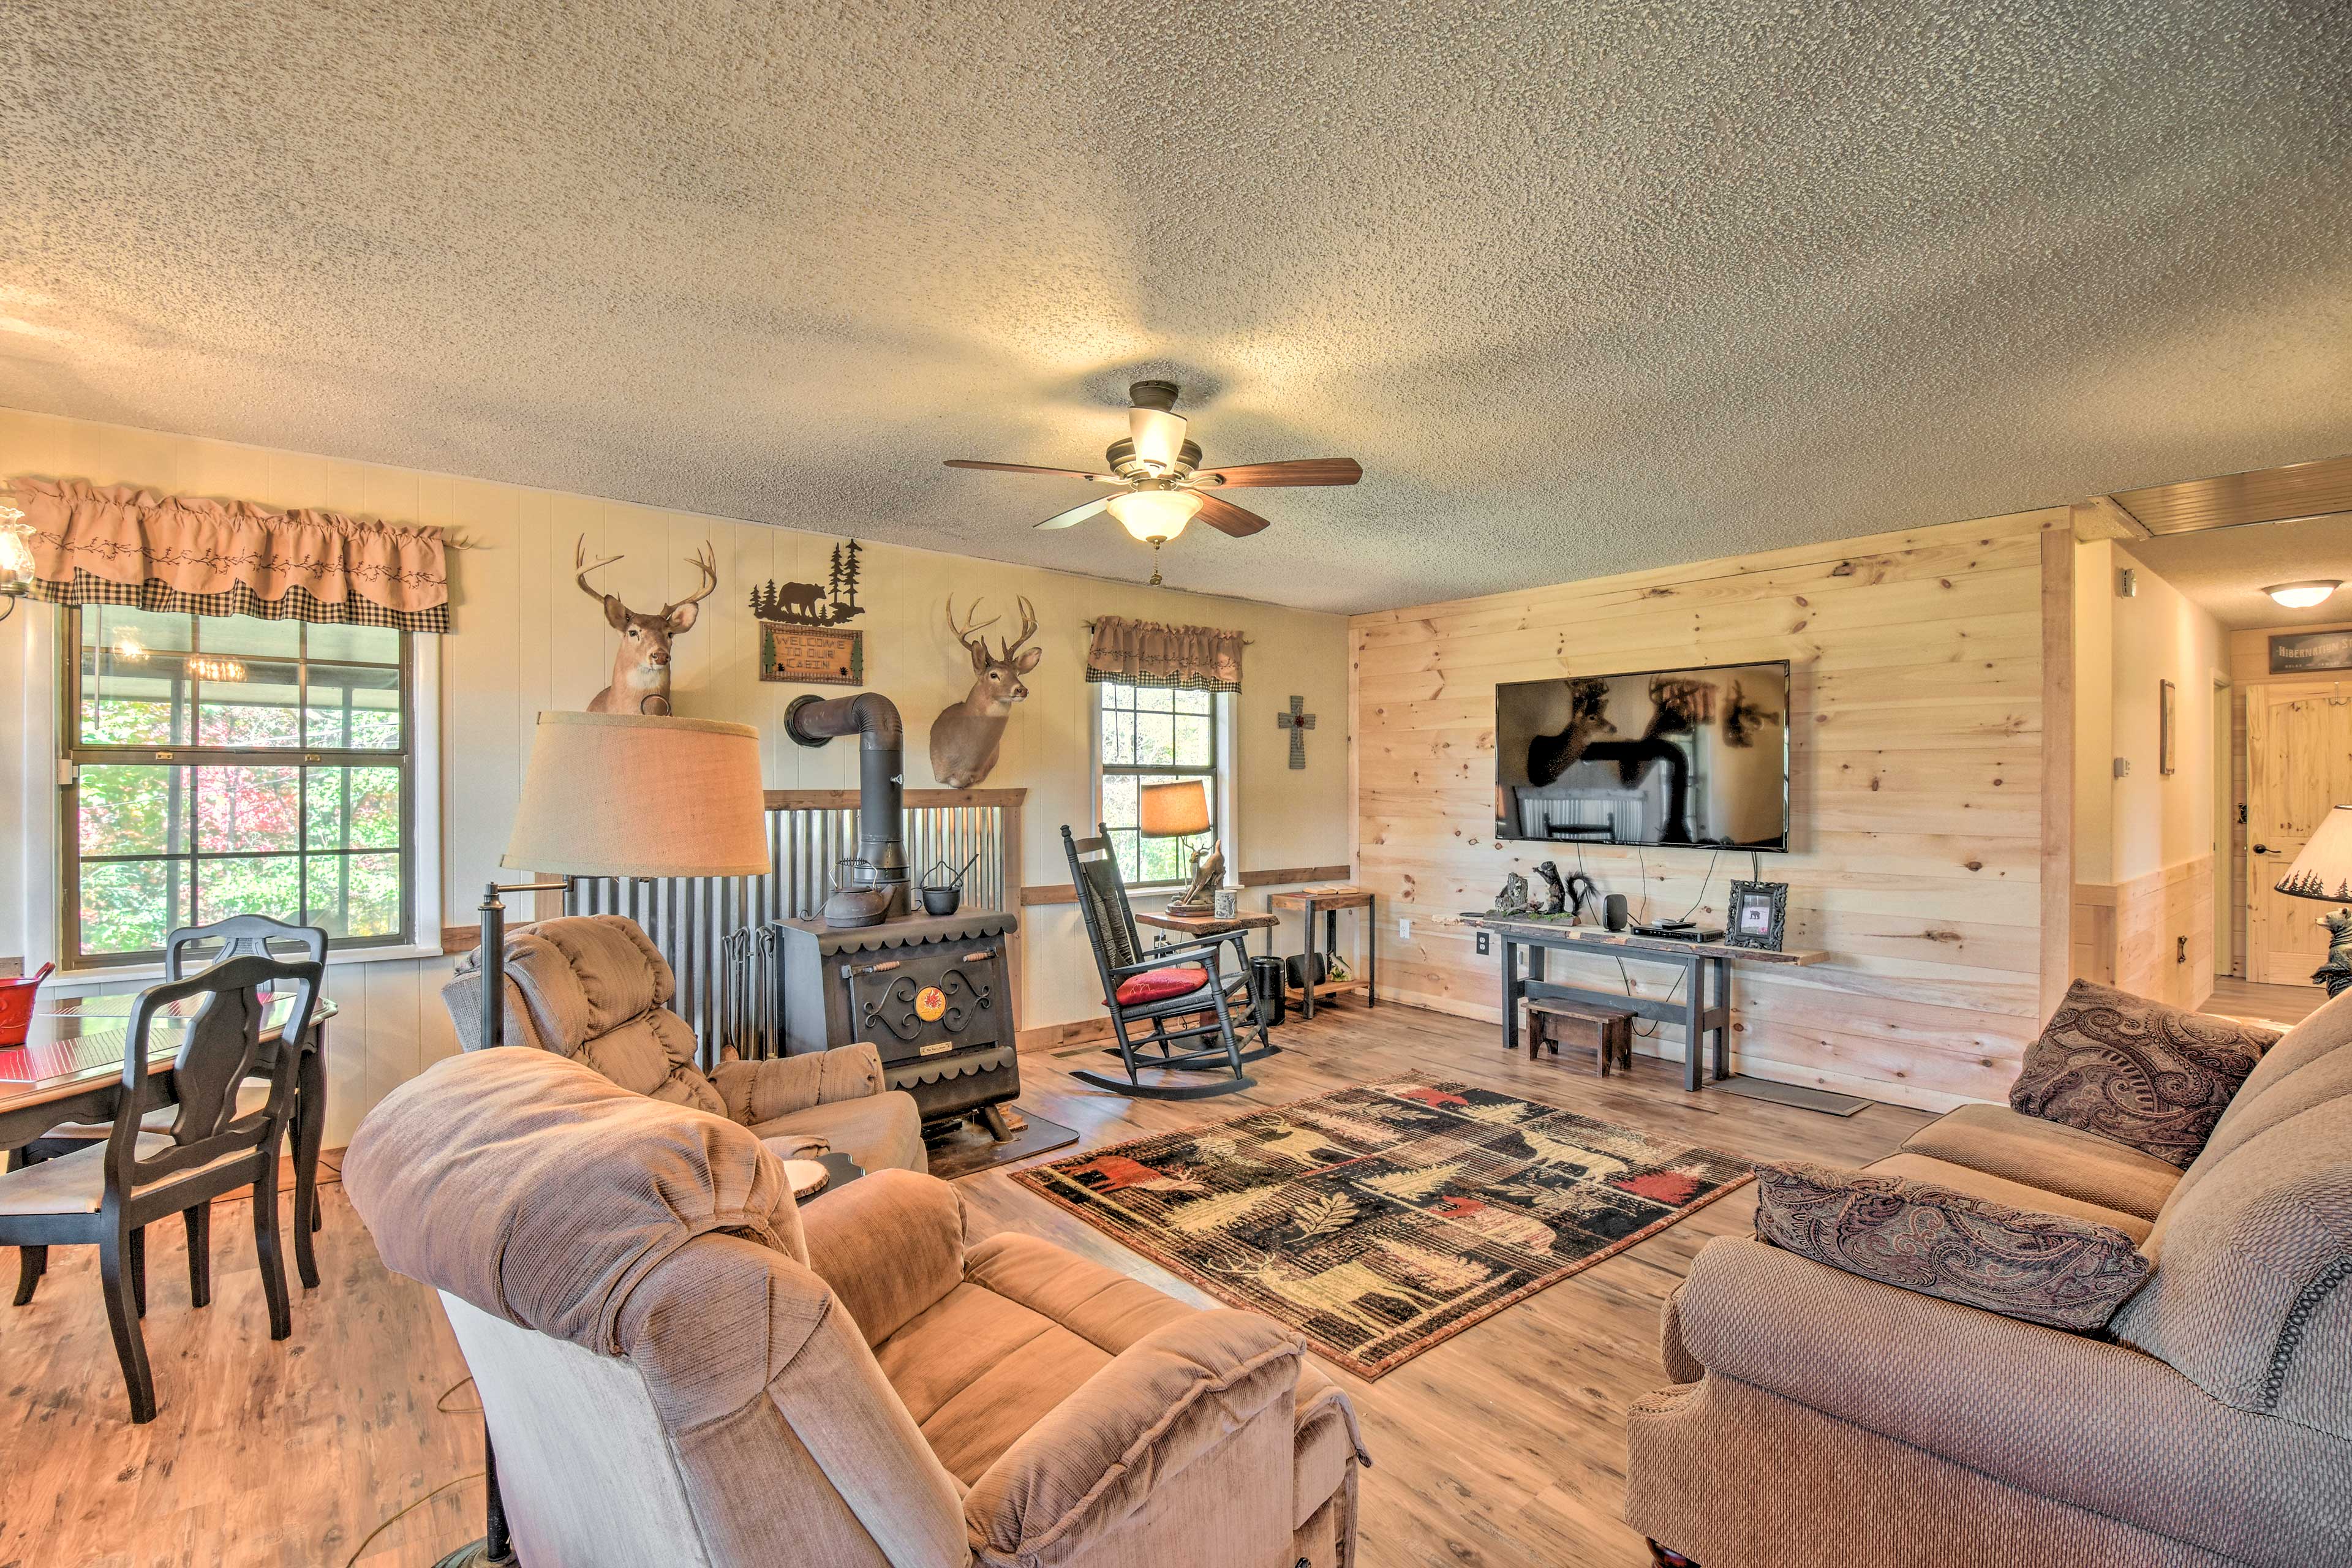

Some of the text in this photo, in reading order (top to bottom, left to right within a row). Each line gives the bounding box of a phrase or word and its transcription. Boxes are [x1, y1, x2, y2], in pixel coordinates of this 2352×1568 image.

[775, 636, 845, 649] WELCOME
[785, 646, 835, 659] TO OUR
[2278, 641, 2339, 658] HIBERNATION
[786, 658, 829, 669] CABIN
